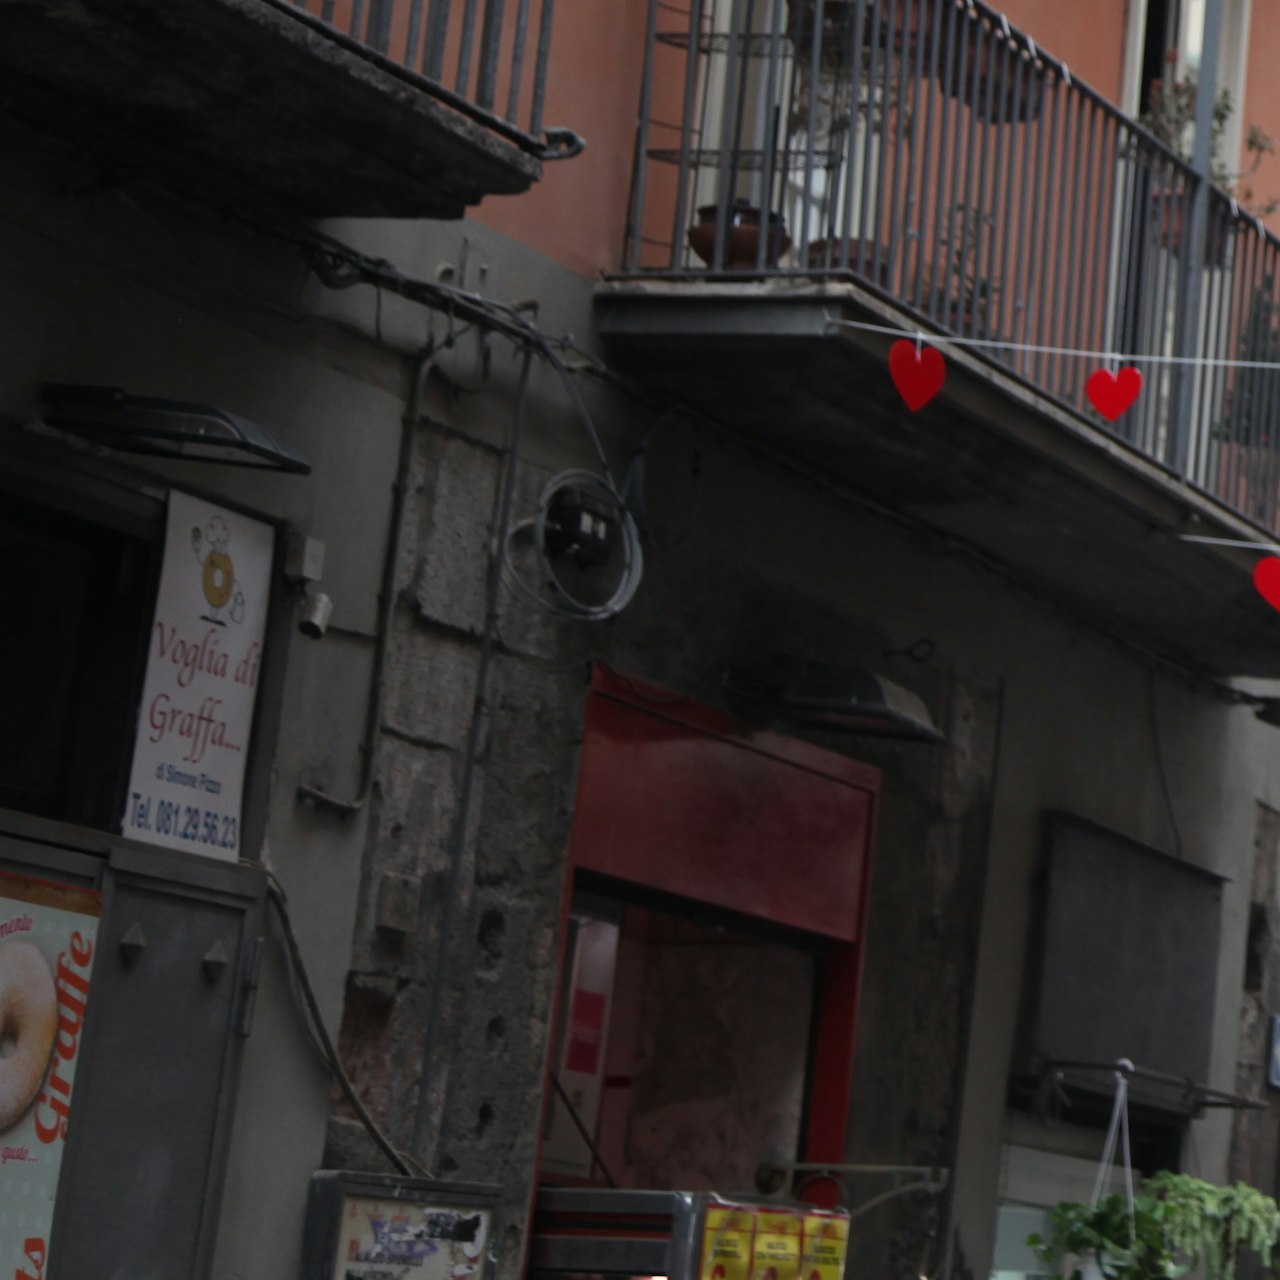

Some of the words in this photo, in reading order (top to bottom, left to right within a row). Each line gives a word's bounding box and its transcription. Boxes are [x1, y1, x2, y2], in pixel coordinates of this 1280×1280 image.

[156, 622, 230, 687] Voglia
[234, 642, 259, 689] di
[130, 792, 151, 831] Tel.
